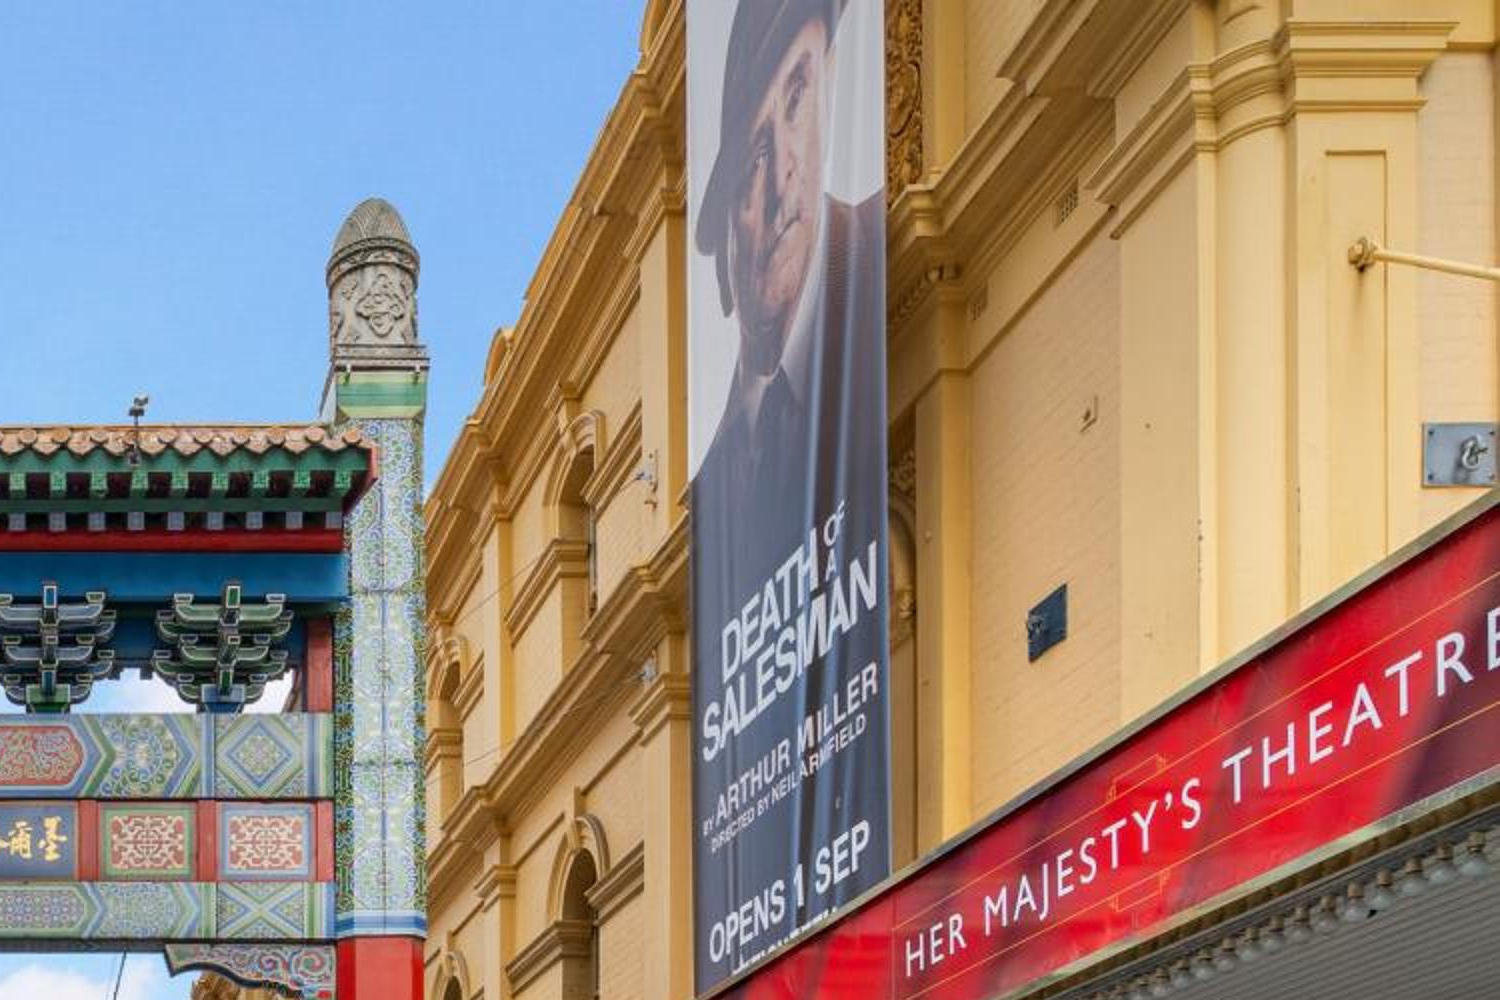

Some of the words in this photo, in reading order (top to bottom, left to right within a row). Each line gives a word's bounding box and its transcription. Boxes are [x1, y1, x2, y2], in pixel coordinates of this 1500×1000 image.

[703, 541, 878, 763] SALESMAN
[721, 528, 817, 684] DEATH
[823, 500, 846, 548] OF
[825, 550, 837, 582] A
[703, 814, 715, 837] BY
[715, 738, 791, 826] ARTHUR
[797, 661, 878, 757] MILLER
[711, 807, 755, 854] DIRECTED
[757, 794, 769, 818] BY
[771, 768, 799, 806] NEIL
[799, 713, 867, 780] ARMFIELD
[708, 890, 785, 964] OPENS
[793, 862, 804, 906] 1
[815, 820, 870, 896] SEP
[904, 912, 967, 978] HER
[983, 777, 1201, 937] MAJESTY'S
